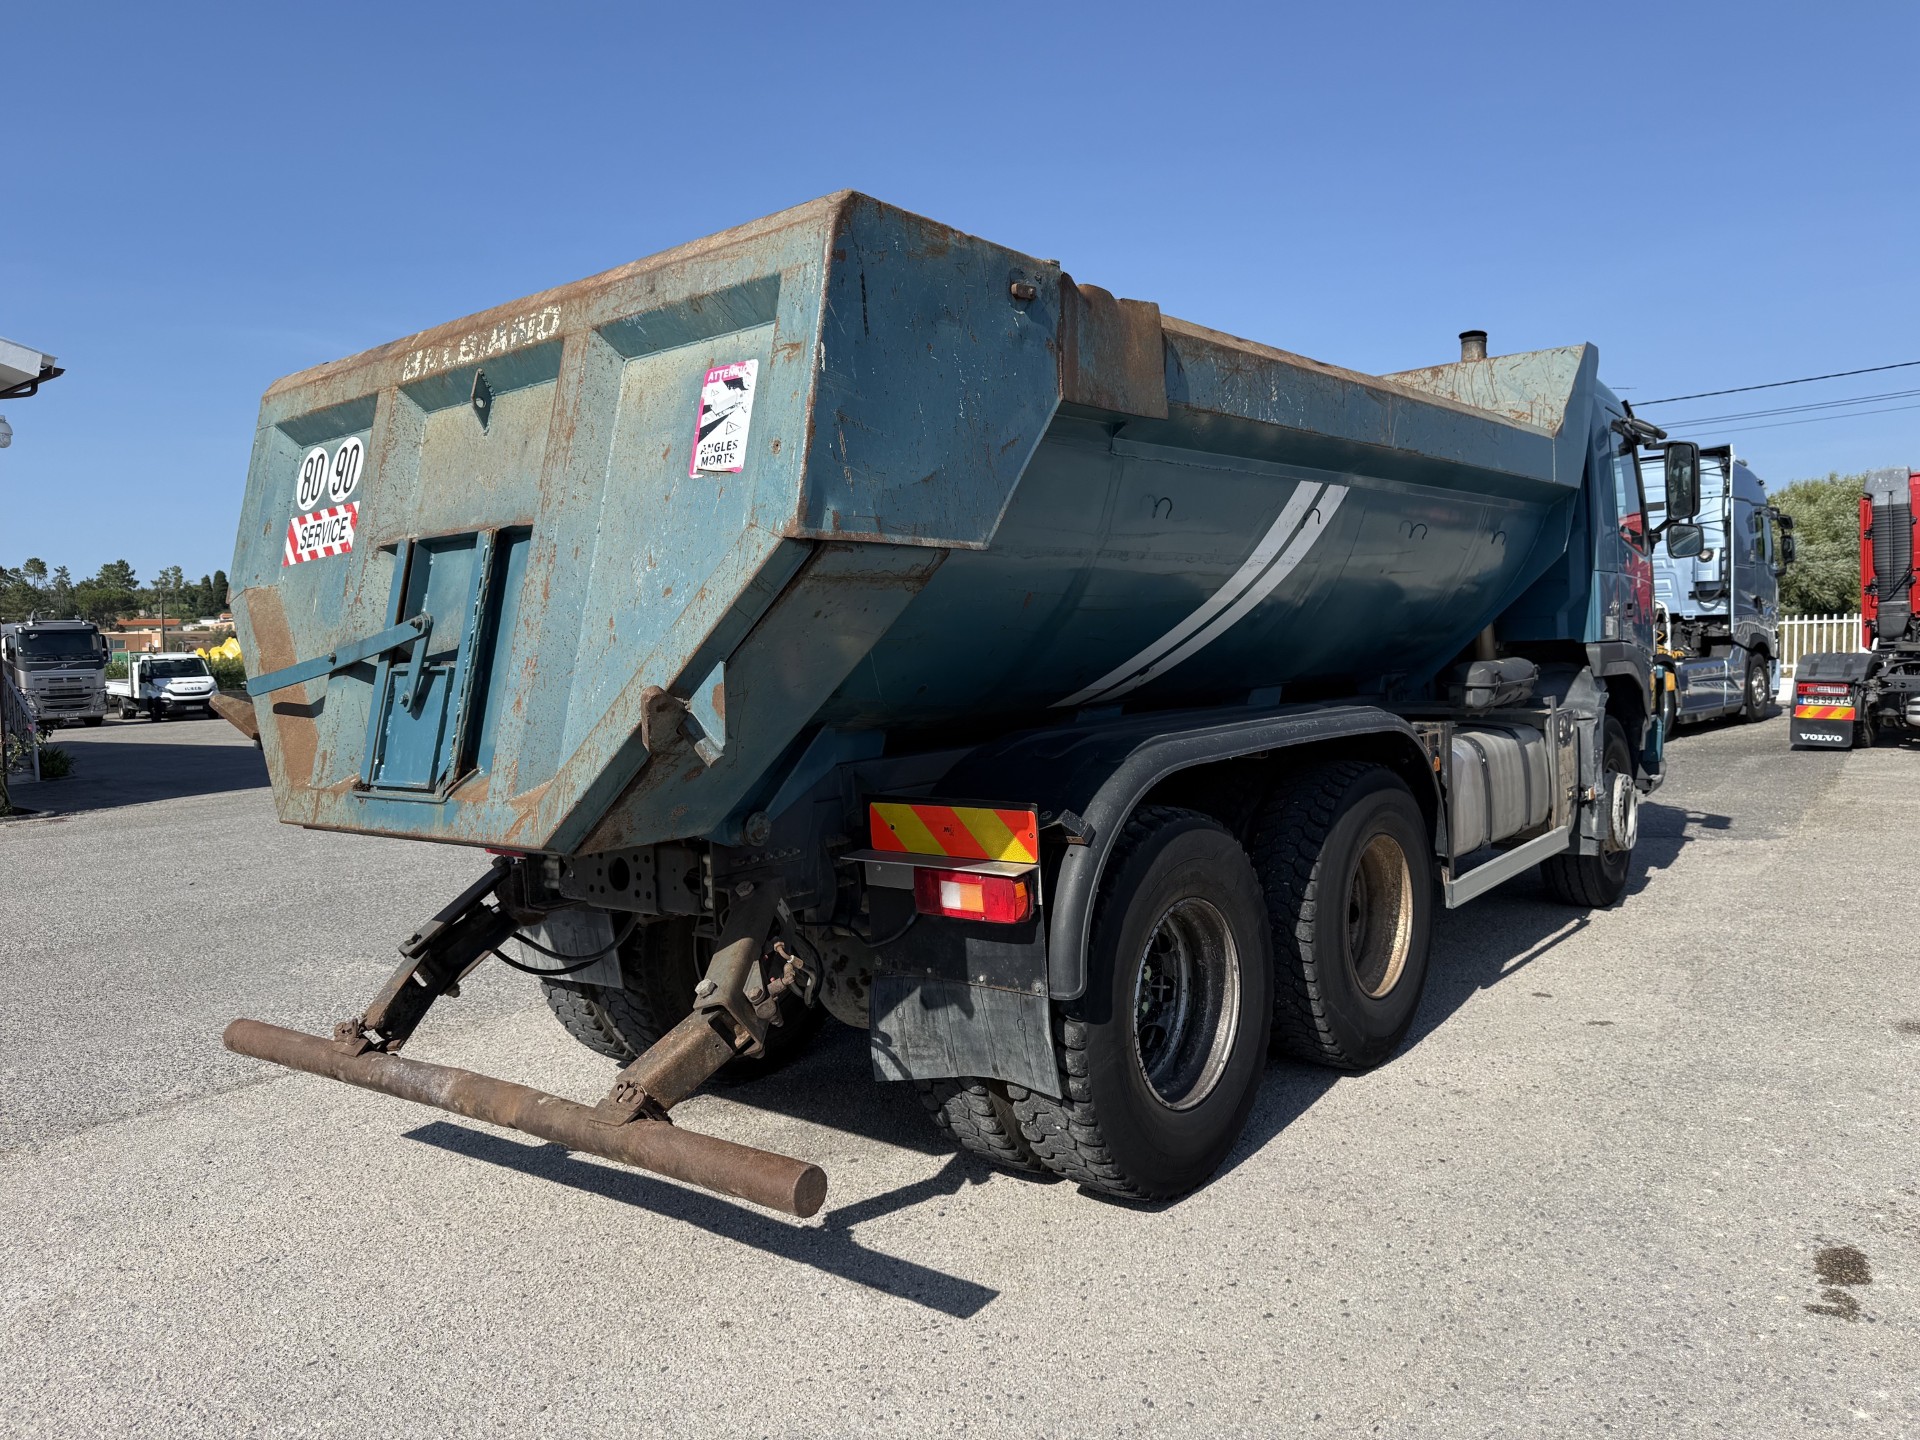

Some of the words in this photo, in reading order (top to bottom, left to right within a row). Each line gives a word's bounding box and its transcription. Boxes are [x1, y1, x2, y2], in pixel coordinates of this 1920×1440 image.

[331, 443, 360, 496] 90
[700, 452, 735, 467] MORTS
[301, 453, 325, 505] 80
[300, 516, 349, 551] SERVICE
[1800, 733, 1843, 742] VOLVO
